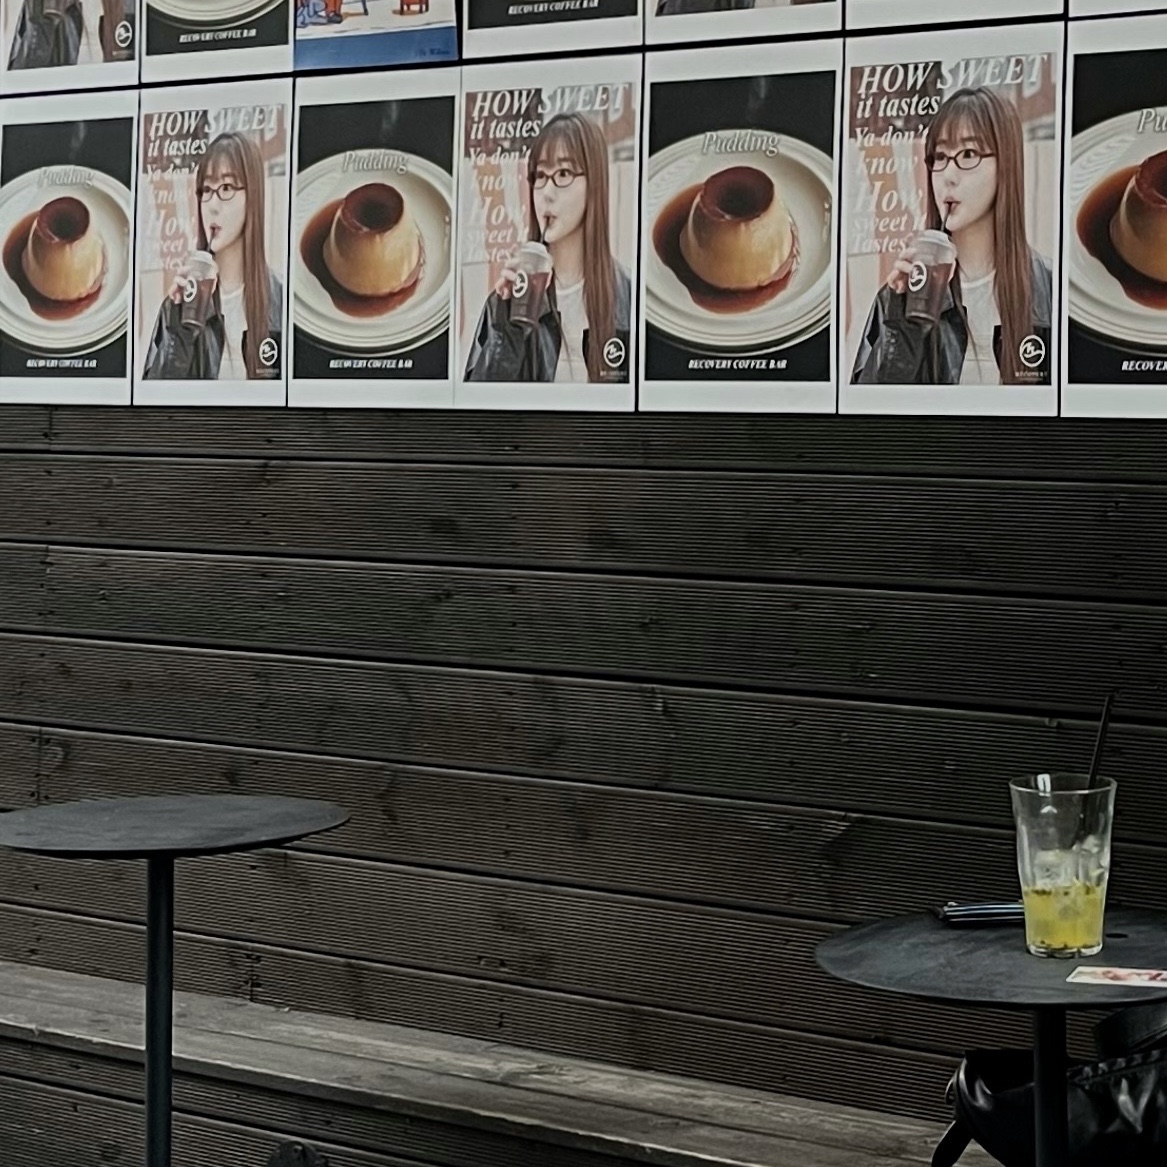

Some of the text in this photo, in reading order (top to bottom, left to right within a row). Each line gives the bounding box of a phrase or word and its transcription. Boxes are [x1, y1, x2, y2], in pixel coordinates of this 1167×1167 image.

[857, 54, 1049, 95] HOW SWEET
[472, 83, 630, 118] HOW SWEET
[856, 91, 941, 119] it tastes
[149, 104, 282, 137] HOW SWEET
[470, 117, 542, 140] it tastes
[147, 137, 209, 157] it tastes
[702, 129, 779, 157] Pudding
[854, 127, 875, 147] Ya
[342, 149, 408, 175] Pudding
[688, 359, 788, 369] RECOVERY COFFEE BAR
